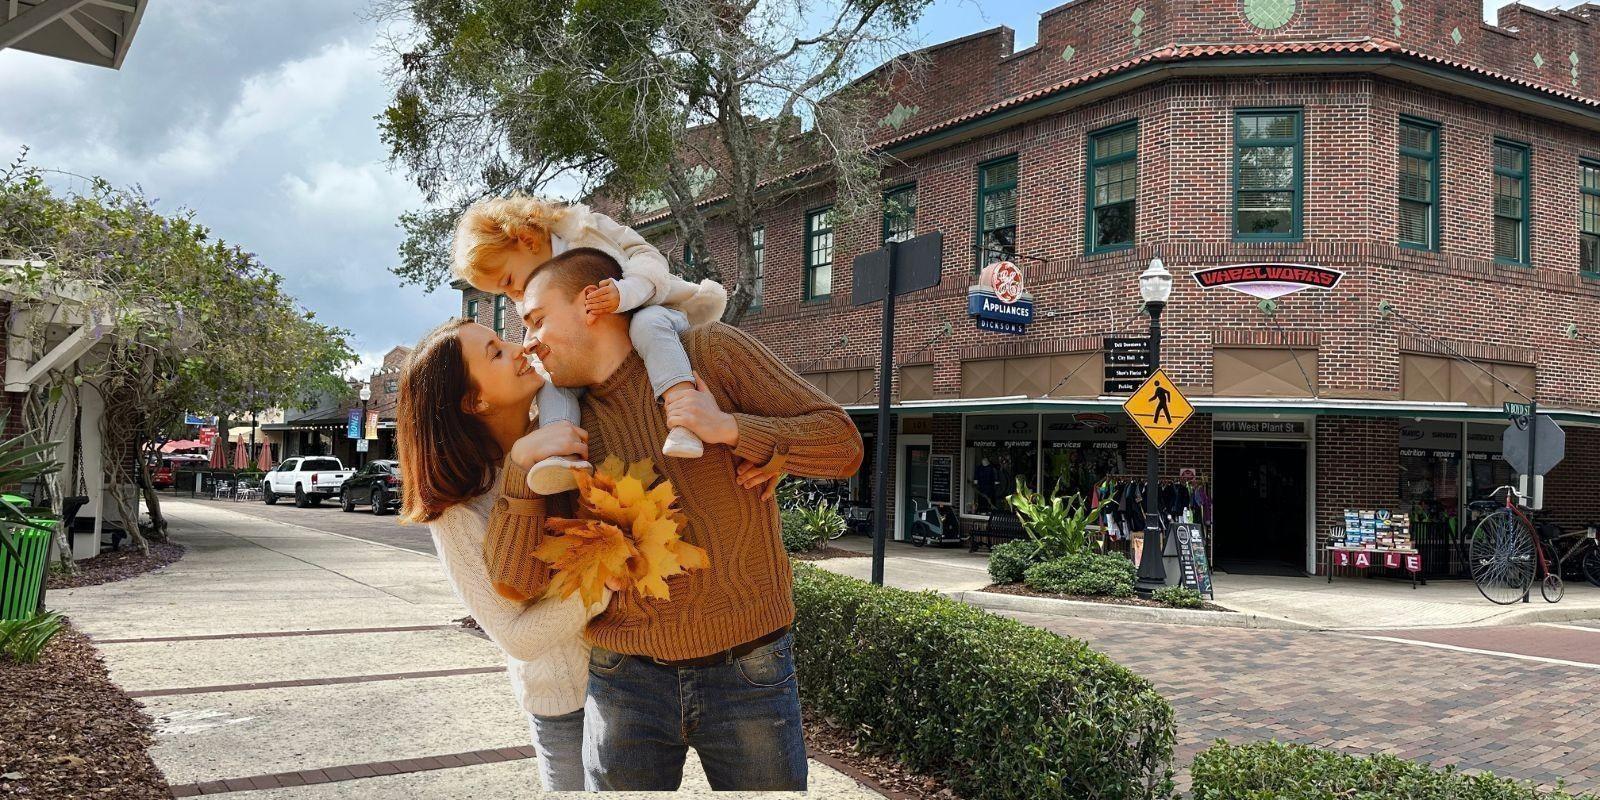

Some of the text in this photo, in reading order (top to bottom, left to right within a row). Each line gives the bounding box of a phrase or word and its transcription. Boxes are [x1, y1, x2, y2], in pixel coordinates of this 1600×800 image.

[1201, 267, 1335, 285] WHEELWORKS
[983, 298, 1029, 317] APPLIANCES
[1505, 403, 1531, 416] N BOYD ST
[1220, 421, 1294, 432] 101 West Plant St
[1092, 441, 1118, 449] rentals
[1400, 449, 1426, 457] nutrition
